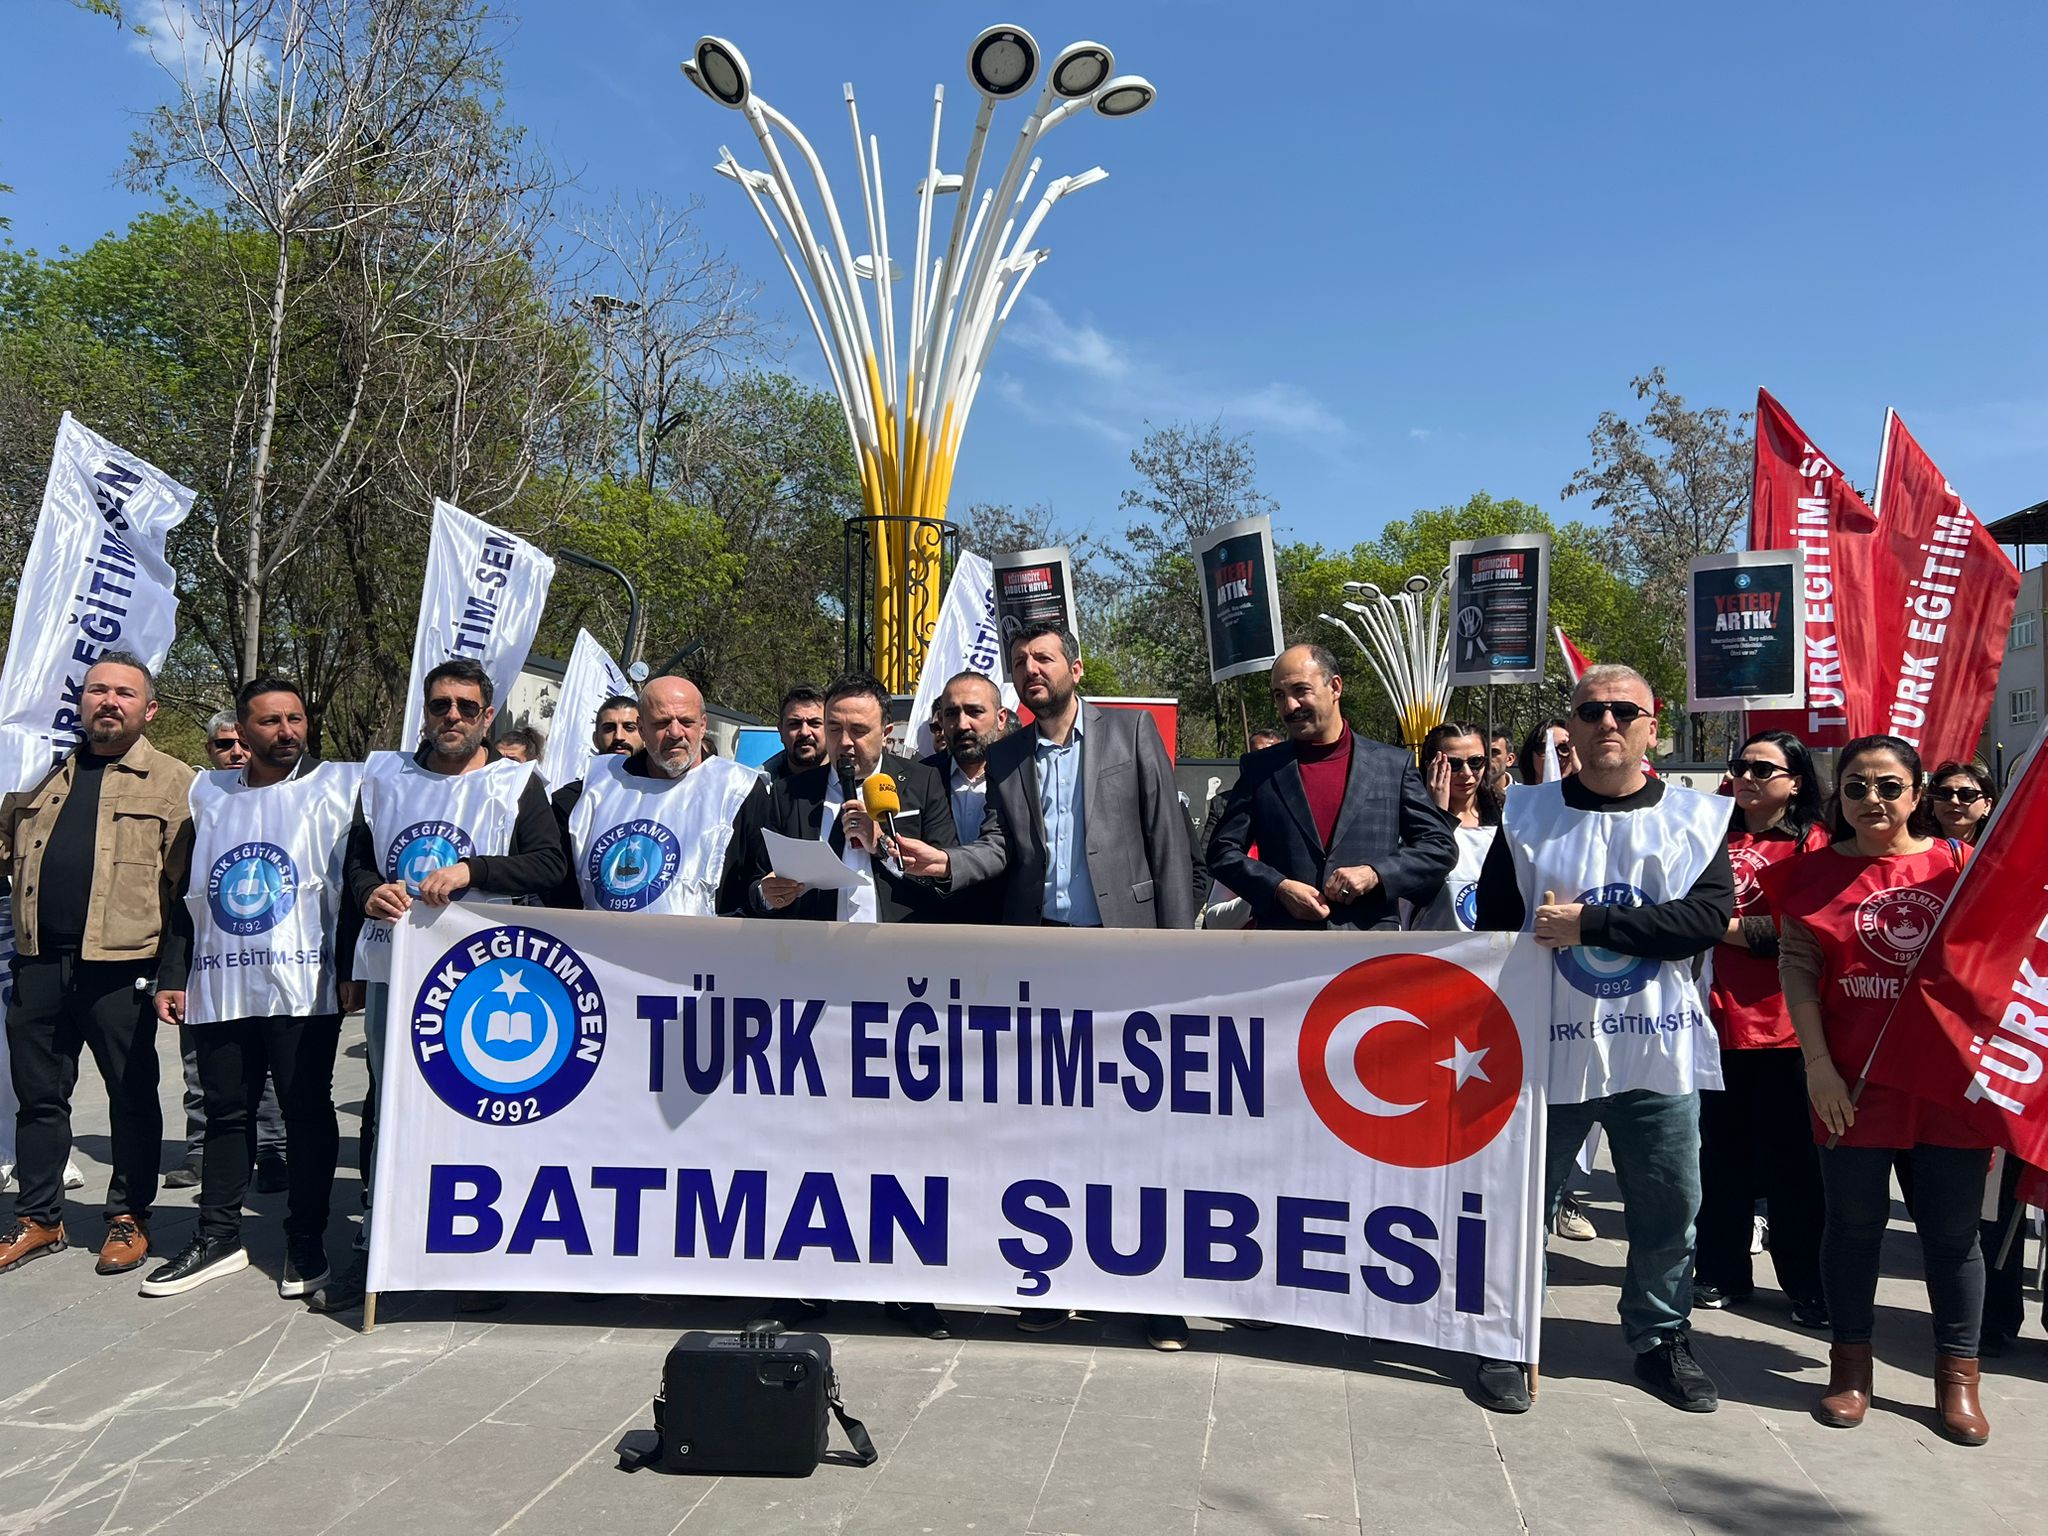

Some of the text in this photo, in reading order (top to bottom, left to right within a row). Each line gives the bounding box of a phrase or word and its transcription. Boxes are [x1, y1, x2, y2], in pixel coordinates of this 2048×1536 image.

[444, 529, 518, 661] İTİM-SEN
[411, 823, 470, 859] EĞİTİM-S
[609, 897, 637, 909] 1992
[232, 920, 262, 933] 1992
[364, 924, 392, 943] ÜRK
[415, 930, 603, 1063] TÜRK EĞİTİM-SEN
[1594, 979, 1632, 995] 1992
[636, 974, 1265, 1118] TÜRK EĞİTİM-SEN
[477, 1097, 541, 1122] 1992
[425, 1164, 1488, 1317] BATMAN ŞUBESİ
